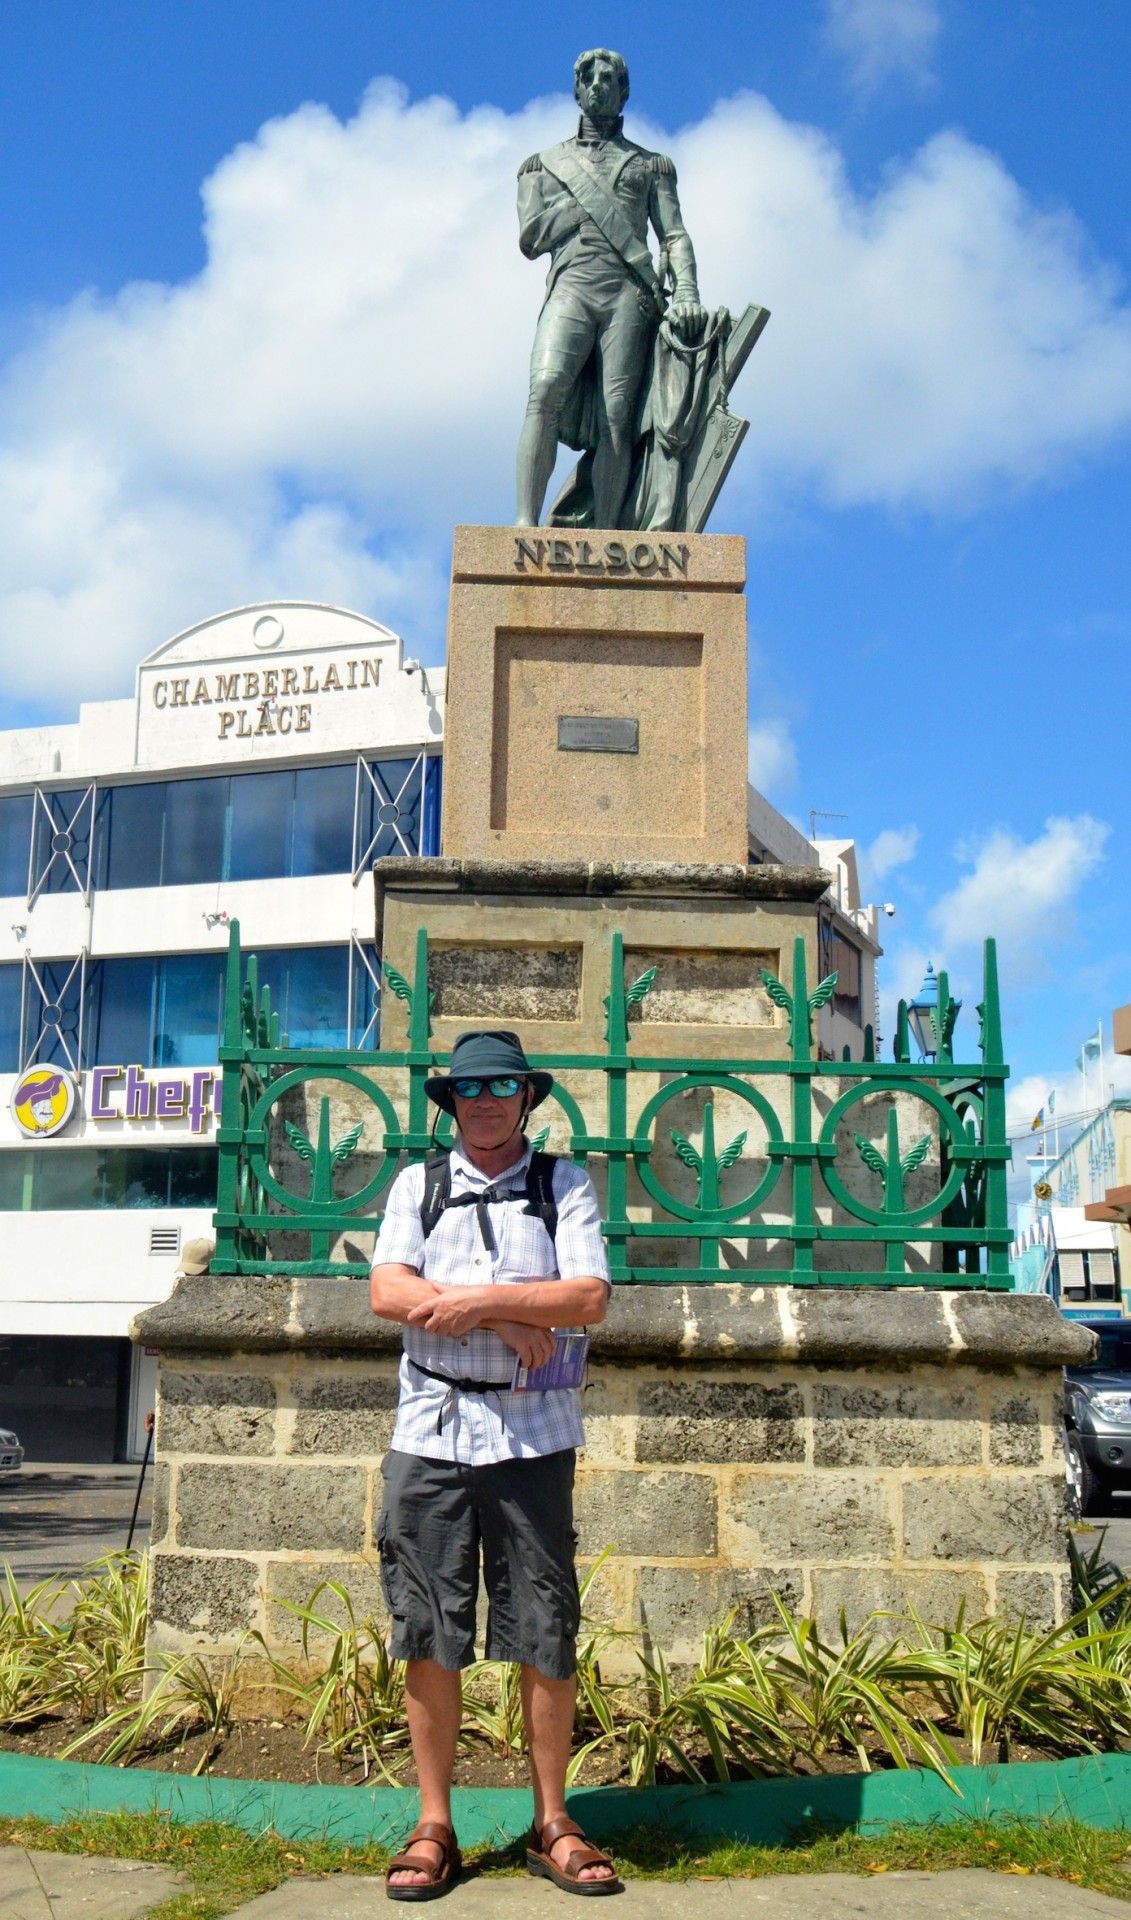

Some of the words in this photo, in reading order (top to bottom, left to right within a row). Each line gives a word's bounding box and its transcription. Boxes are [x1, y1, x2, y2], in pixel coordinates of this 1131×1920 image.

[514, 538, 688, 571] NELSON
[152, 657, 383, 709] CHAMBERLAIN
[217, 703, 312, 740] PLACE
